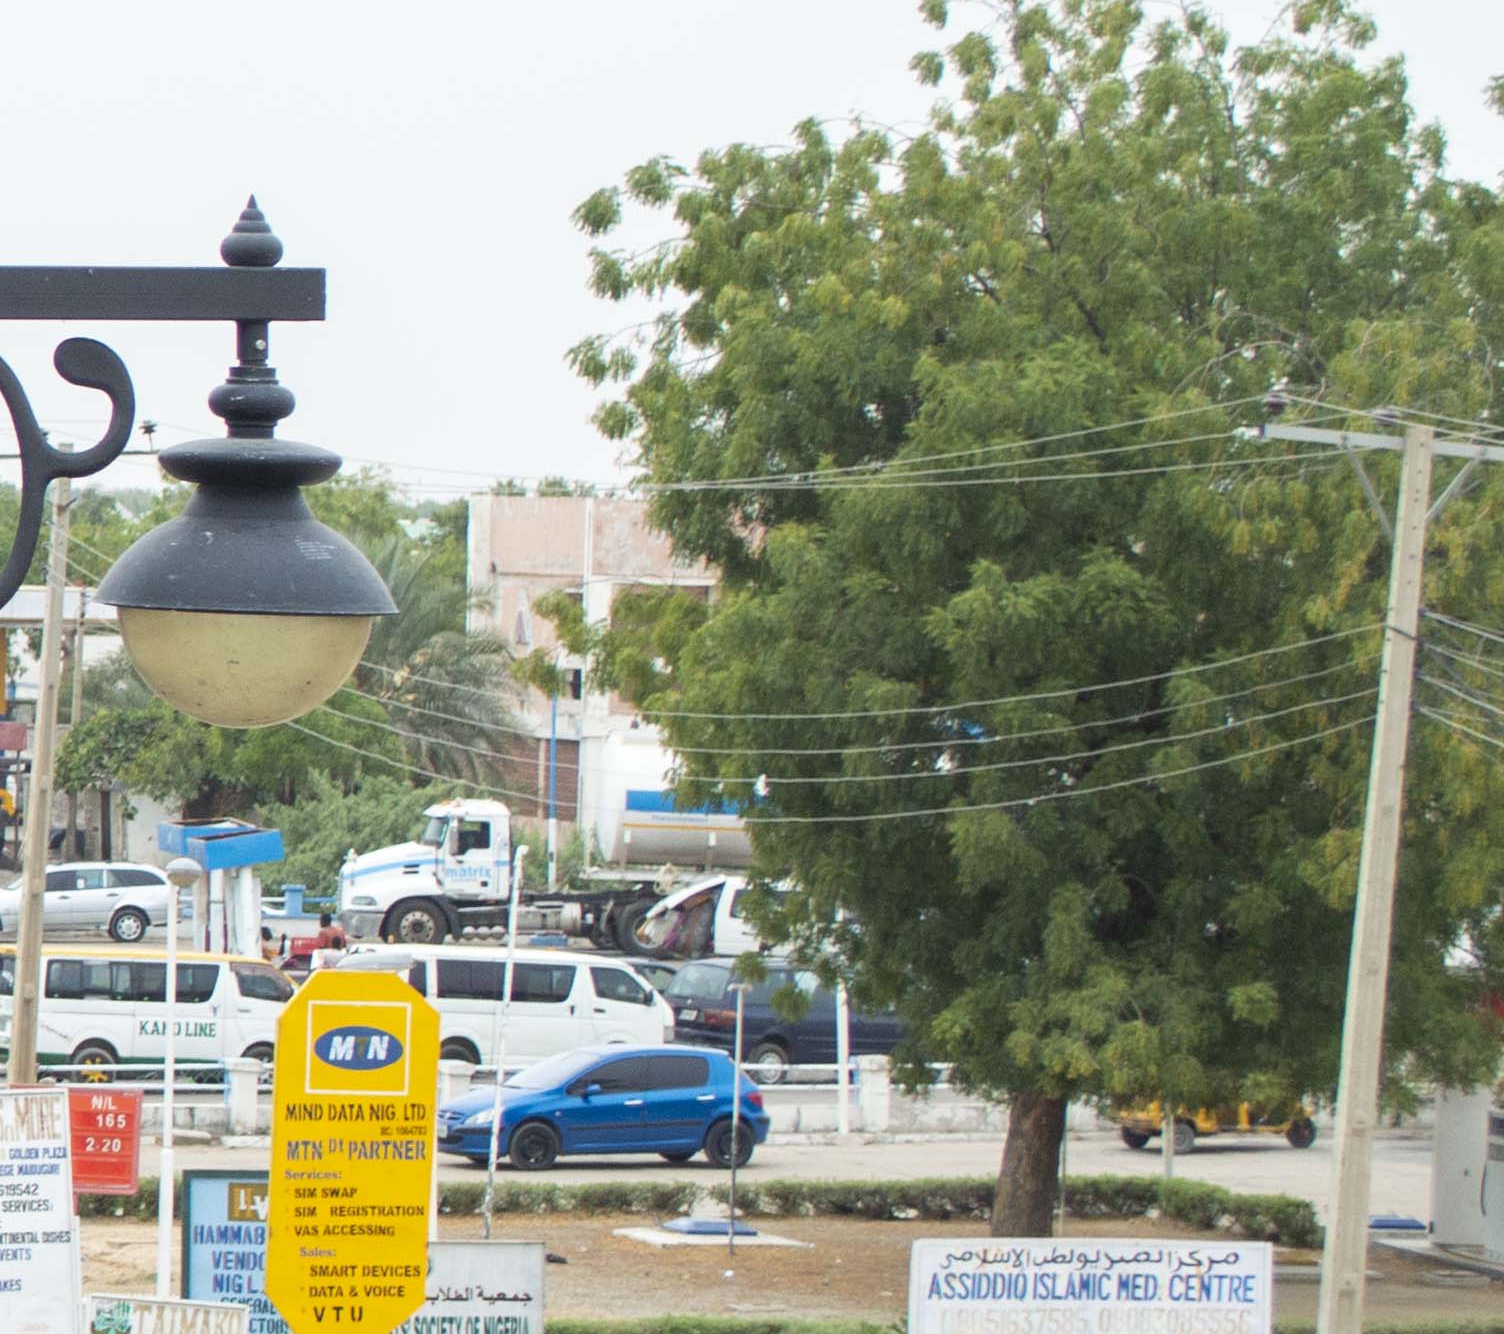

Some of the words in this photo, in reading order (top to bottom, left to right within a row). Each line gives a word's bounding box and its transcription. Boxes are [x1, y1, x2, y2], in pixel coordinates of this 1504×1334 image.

[185, 1022, 216, 1038] LINE
[329, 1035, 390, 1060] MTN
[285, 1104, 323, 1121] MIND
[328, 1104, 364, 1121] DATA
[96, 1114, 126, 1128] 165
[9, 1148, 38, 1159] GOLDEN
[42, 1147, 67, 1159] PLAZA
[287, 1140, 322, 1160] MTN
[348, 1140, 426, 1160] PARTNER
[285, 1170, 342, 1179] Services:
[295, 1188, 316, 1199] SIM
[321, 1187, 357, 1198] SWAP
[295, 1206, 316, 1217] SIM
[330, 1206, 424, 1216] REGISTRATION
[42, 1231, 71, 1243] DISHES
[295, 1226, 318, 1237] VAS
[323, 1225, 395, 1236] ACCESSING
[300, 1247, 336, 1257] Sales:
[310, 1265, 357, 1277] SMART
[362, 1265, 421, 1277] DEVICES
[213, 1274, 242, 1293] NIG
[928, 1272, 1026, 1302] ASSIDDIQ
[1033, 1273, 1111, 1302] ISLAMIC
[1168, 1274, 1256, 1303] CENTRE
[309, 1286, 344, 1298] DATA
[349, 1286, 358, 1297] &
[364, 1286, 405, 1297] VOICE
